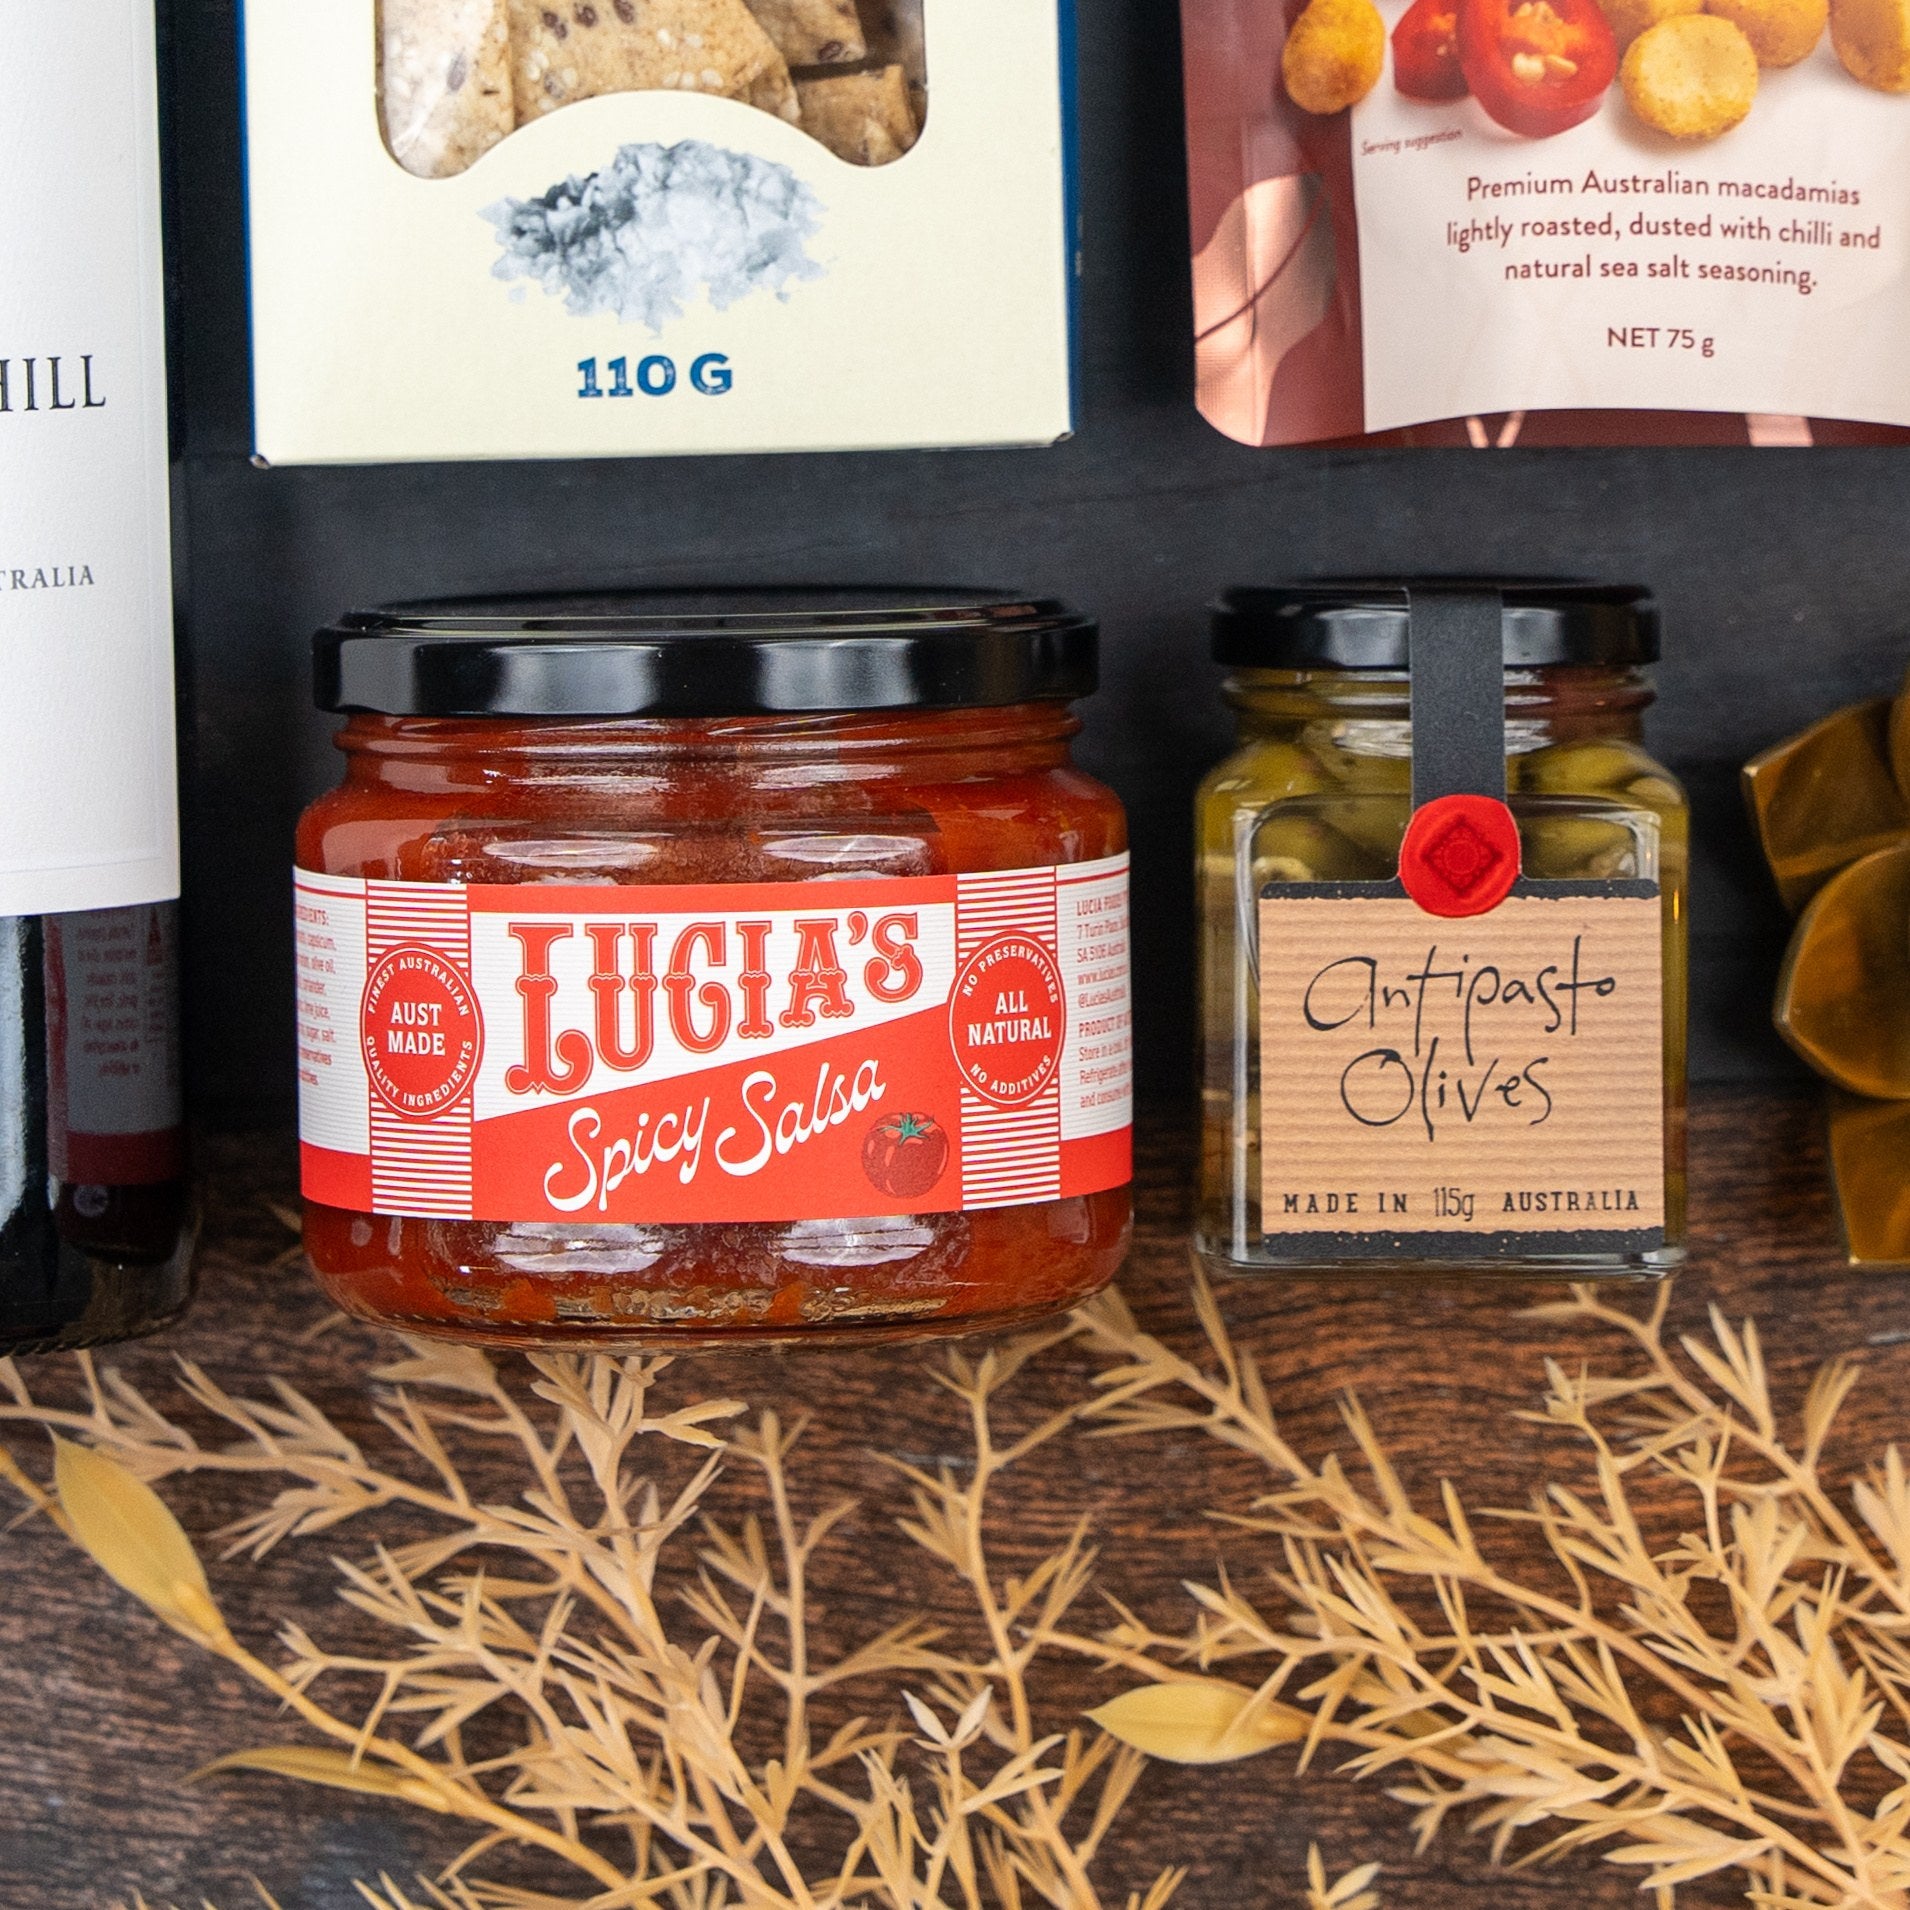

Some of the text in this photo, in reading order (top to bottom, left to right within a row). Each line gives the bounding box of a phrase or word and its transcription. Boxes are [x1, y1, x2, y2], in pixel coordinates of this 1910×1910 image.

[1467, 169, 1861, 205] Premium Australian macadamias
[1446, 211, 1881, 253] lightly roasted, dusted with chilli and
[1504, 253, 1818, 295] natural sea salt seasoning.
[1607, 327, 1660, 348] NET
[577, 352, 733, 398] 110 G
[367, 956, 470, 1017] FINEST AUSTRALIAN
[962, 973, 979, 998] NO
[977, 944, 1059, 1004] PRESERVATIVES
[390, 1002, 442, 1027] AUST
[505, 911, 924, 1096] LUCIA'S
[995, 990, 1029, 1015] ALL
[387, 1030, 446, 1056] MADE
[967, 1016, 1052, 1047] NATURAL
[366, 1035, 473, 1108] QUALITY INGREDIENTS
[970, 1054, 1051, 1096] NO ADDITIVES
[1340, 1036, 1552, 1142] Olives
[543, 1058, 887, 1212] Spicy Salsa
[1283, 1186, 1640, 1222] MADE IN 115g AUSTRALIA
